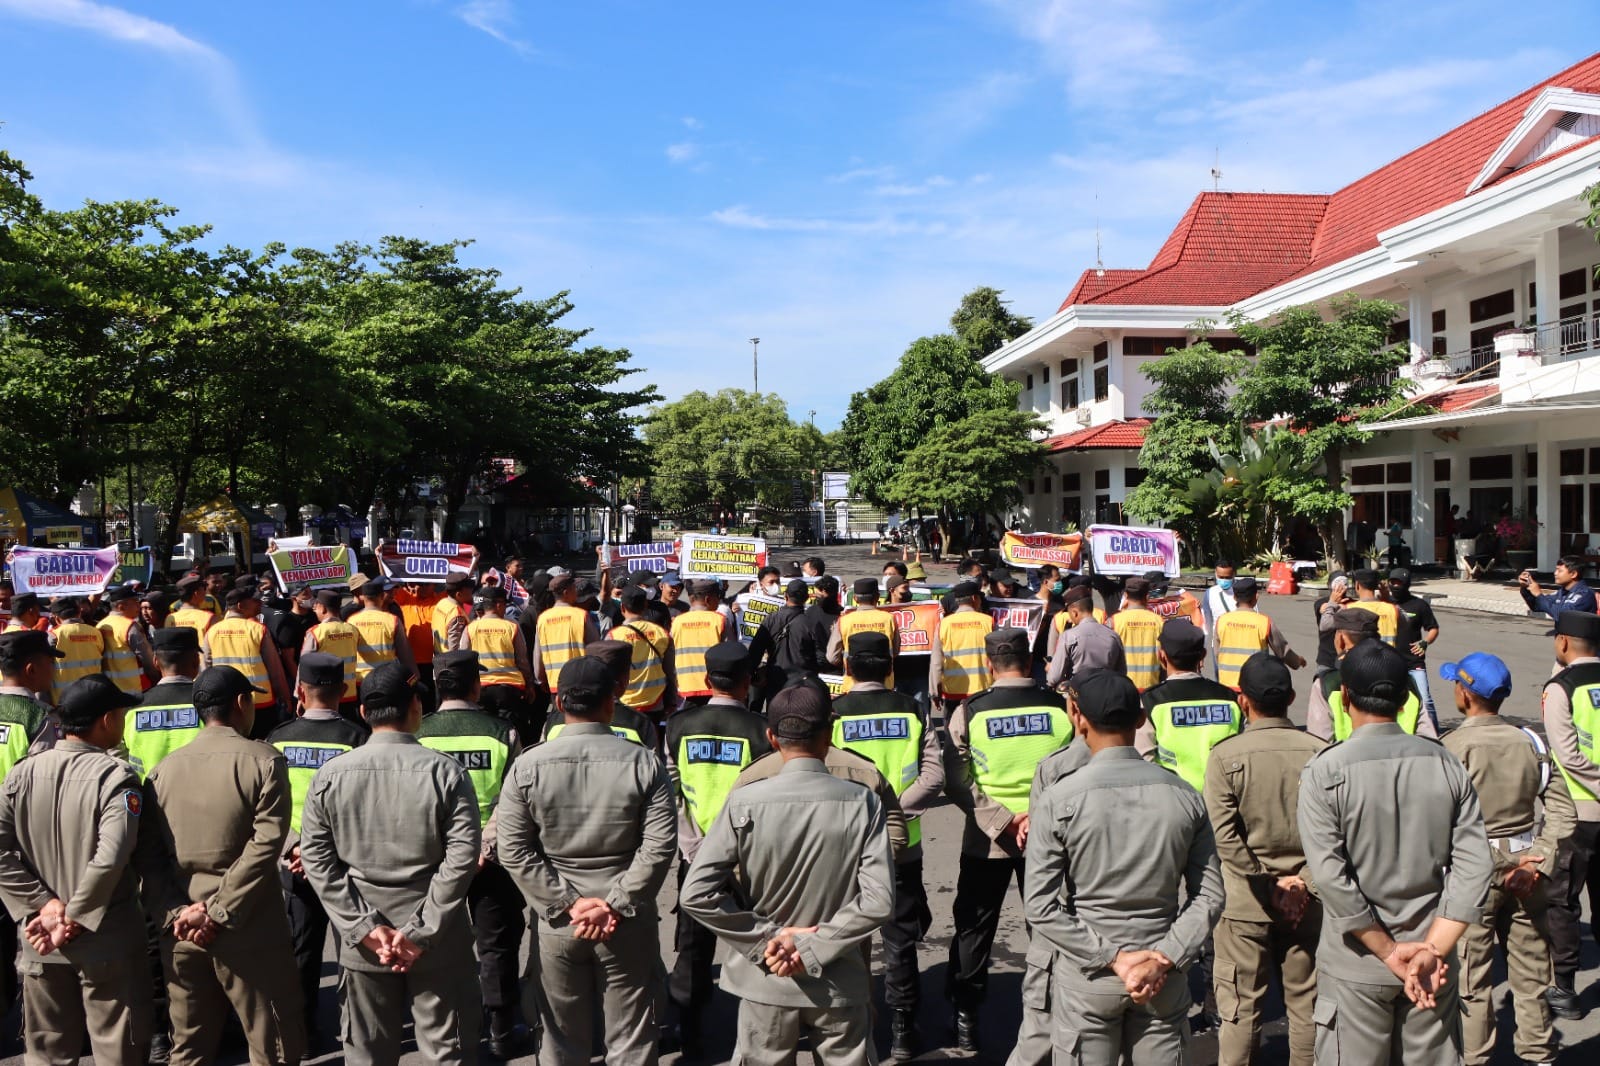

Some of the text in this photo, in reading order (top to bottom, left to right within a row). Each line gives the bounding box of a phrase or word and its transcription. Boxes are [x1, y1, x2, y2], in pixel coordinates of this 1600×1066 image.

[398, 539, 458, 555] NAIKKAN
[619, 542, 674, 557] NAIKKAN
[693, 540, 723, 550] HAPUS
[1110, 536, 1159, 554] CABUT
[289, 547, 334, 567] TOLAK
[717, 552, 757, 563] KONTRAK
[1012, 546, 1072, 563] PHK MASSAL
[1104, 553, 1118, 565] UU
[1118, 554, 1141, 566] CIPTA
[35, 554, 97, 574] CABUT
[406, 557, 450, 575] UMR
[627, 558, 667, 573] UMR
[28, 575, 45, 588] UU
[45, 574, 73, 587] CIPTA
[281, 565, 346, 583] KENAIKAN BBM
[748, 599, 780, 613] HAPUS
[900, 631, 929, 646] SSAL
[137, 709, 197, 729] POLISI
[1173, 705, 1231, 725] POLISI
[843, 718, 908, 740] POLISI
[989, 714, 1049, 737] POLISI
[688, 740, 741, 762] POLISI
